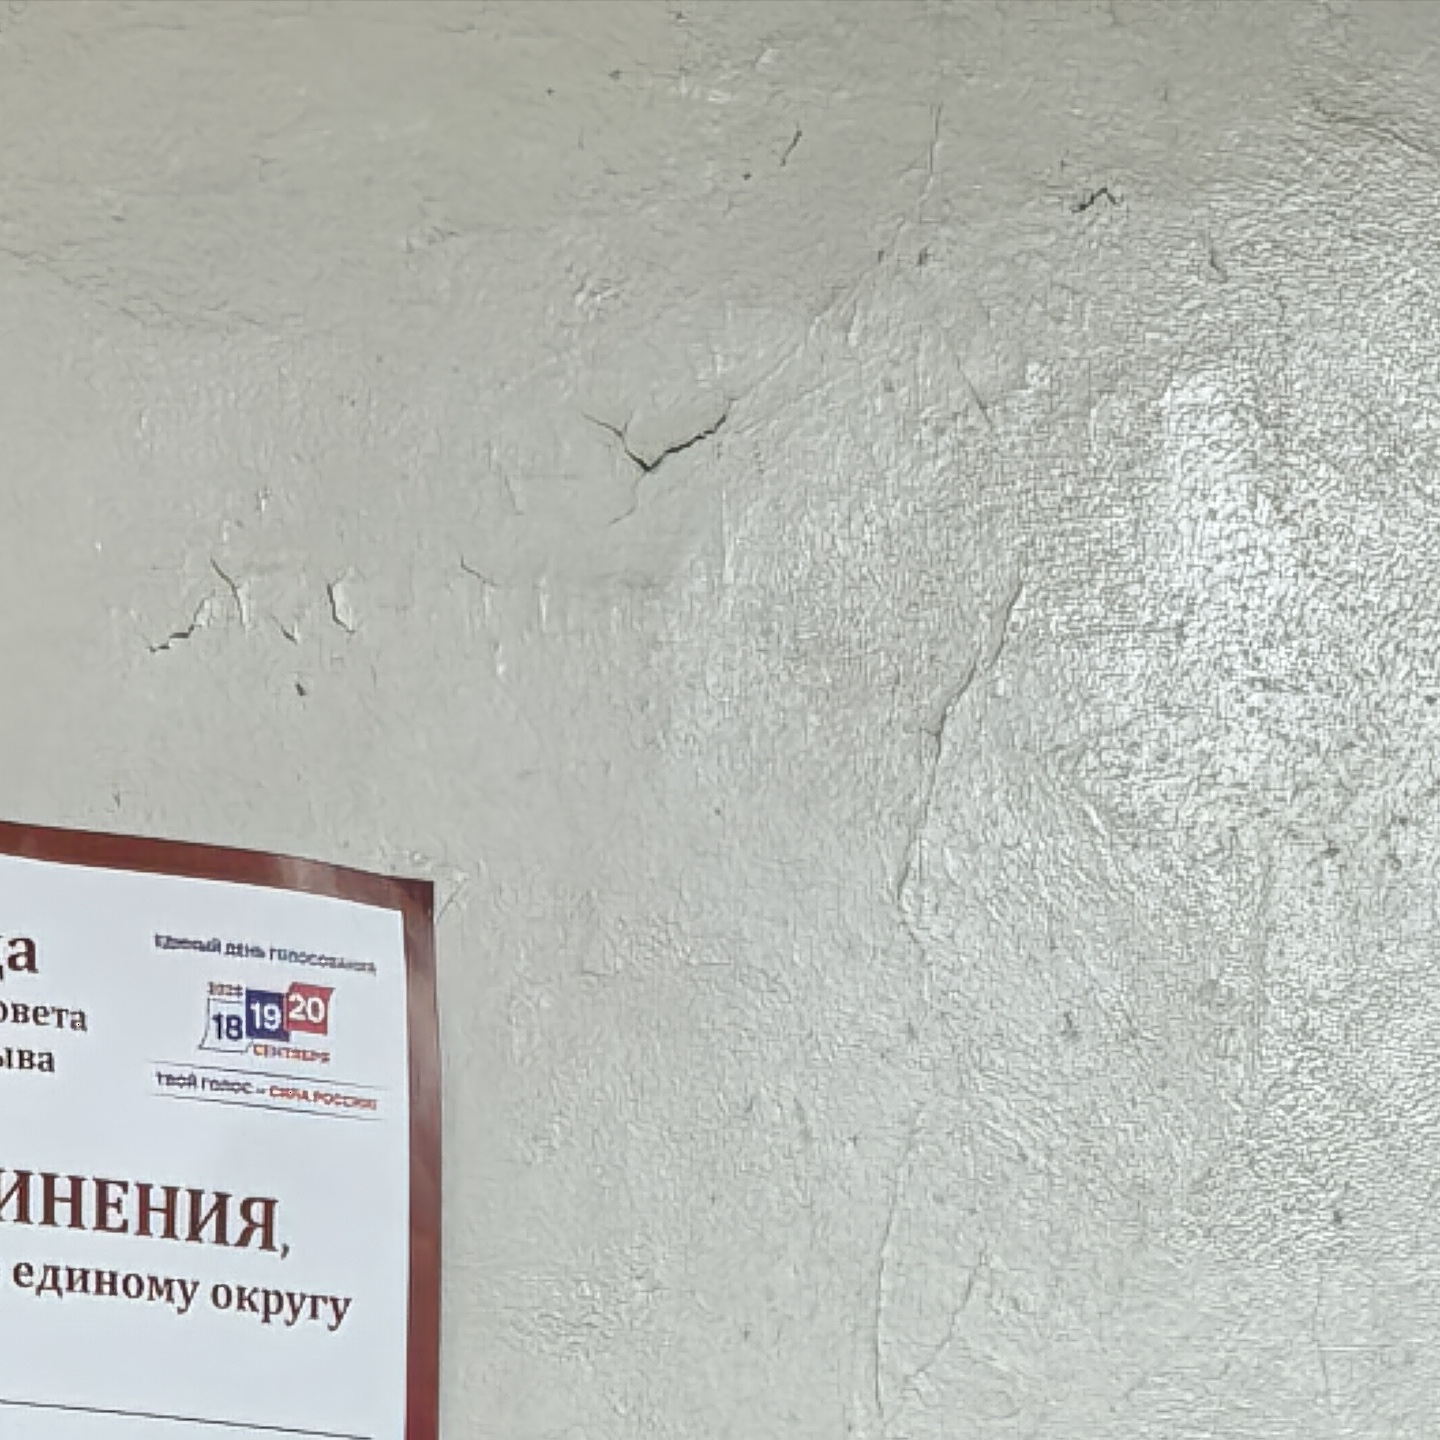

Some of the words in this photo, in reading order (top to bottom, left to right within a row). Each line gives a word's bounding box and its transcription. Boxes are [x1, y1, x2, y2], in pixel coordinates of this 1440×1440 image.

[213, 1011, 243, 1041] 18
[250, 1002, 283, 1031] 19
[288, 992, 326, 1024] 20
[12, 1262, 201, 1315] единому
[210, 1283, 353, 1332] округу
